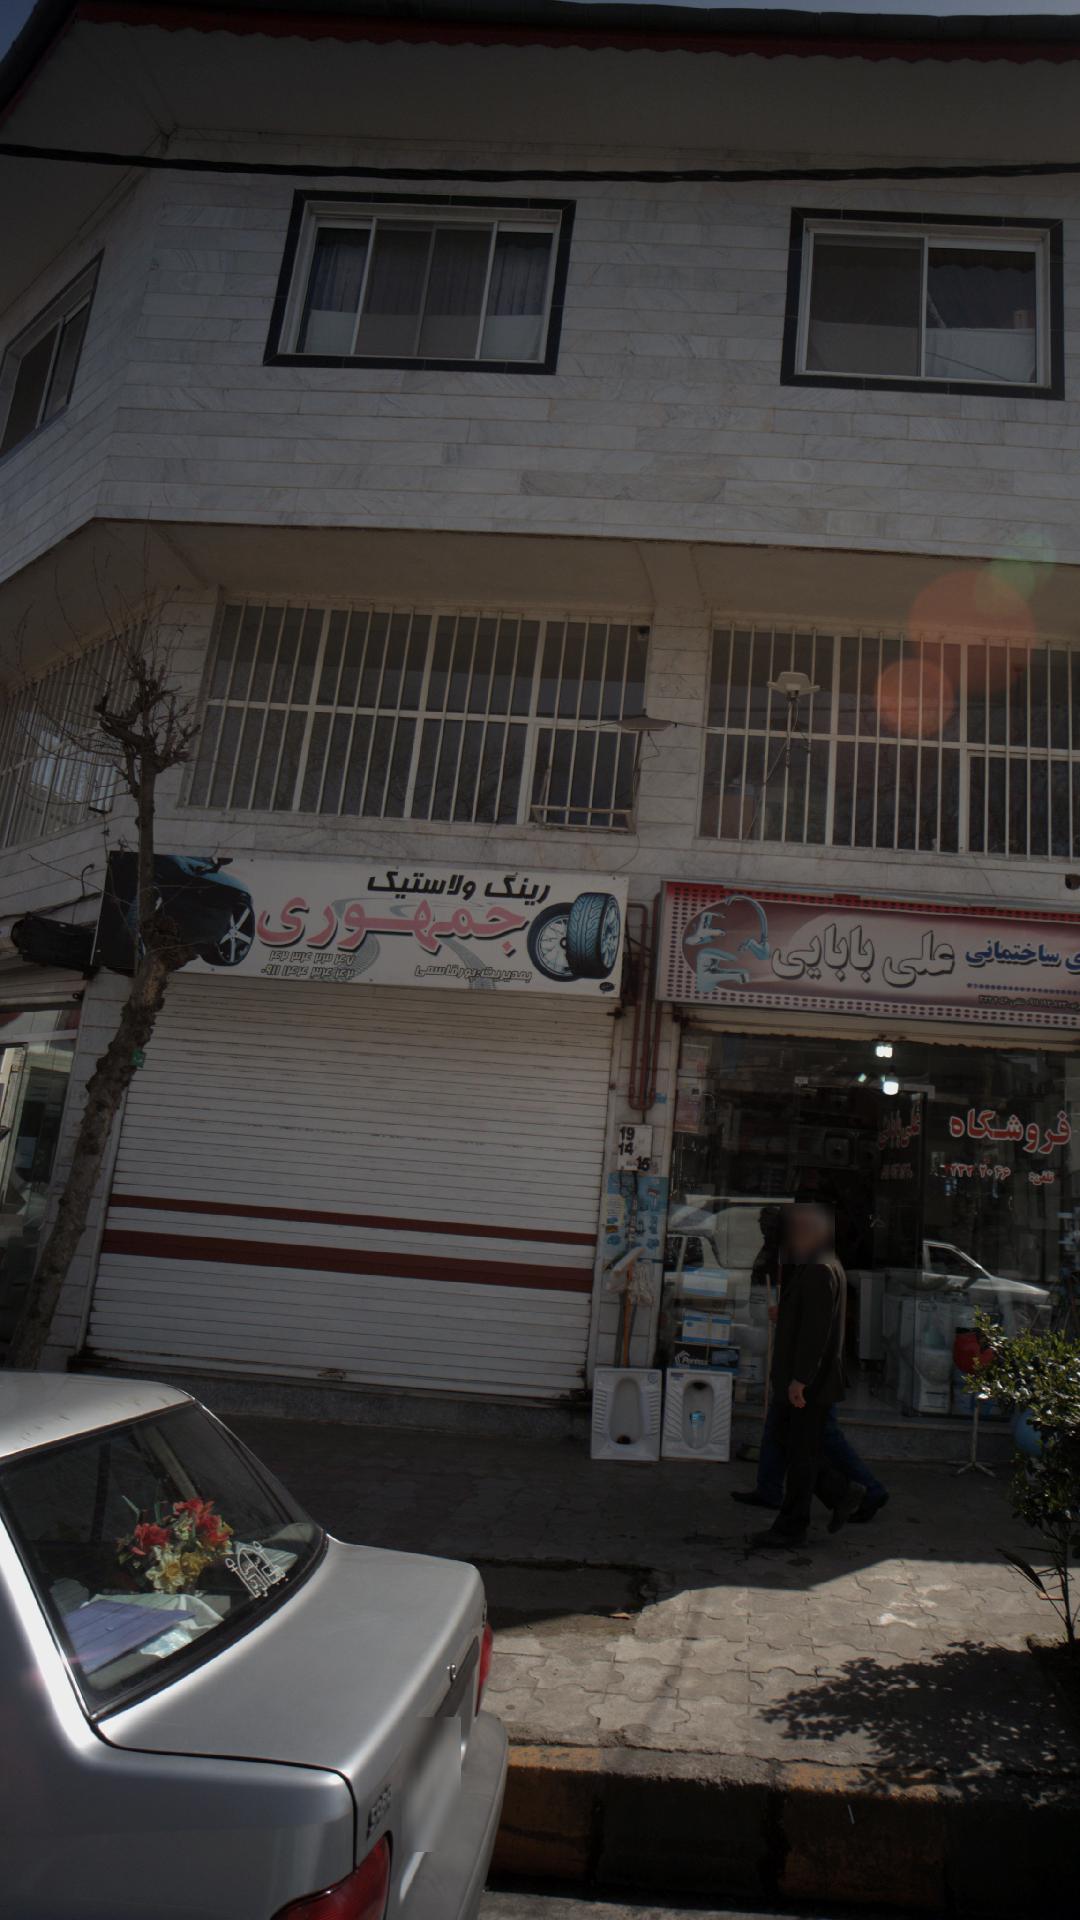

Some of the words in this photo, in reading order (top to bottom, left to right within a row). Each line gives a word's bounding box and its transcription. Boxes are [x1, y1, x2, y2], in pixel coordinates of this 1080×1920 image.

[484, 872, 551, 906] رینگ
[257, 896, 529, 957] جمهوری
[770, 922, 876, 982] بابایی
[882, 930, 956, 988] علی
[965, 938, 1061, 967] ساختمانی
[619, 1127, 635, 1141] 19
